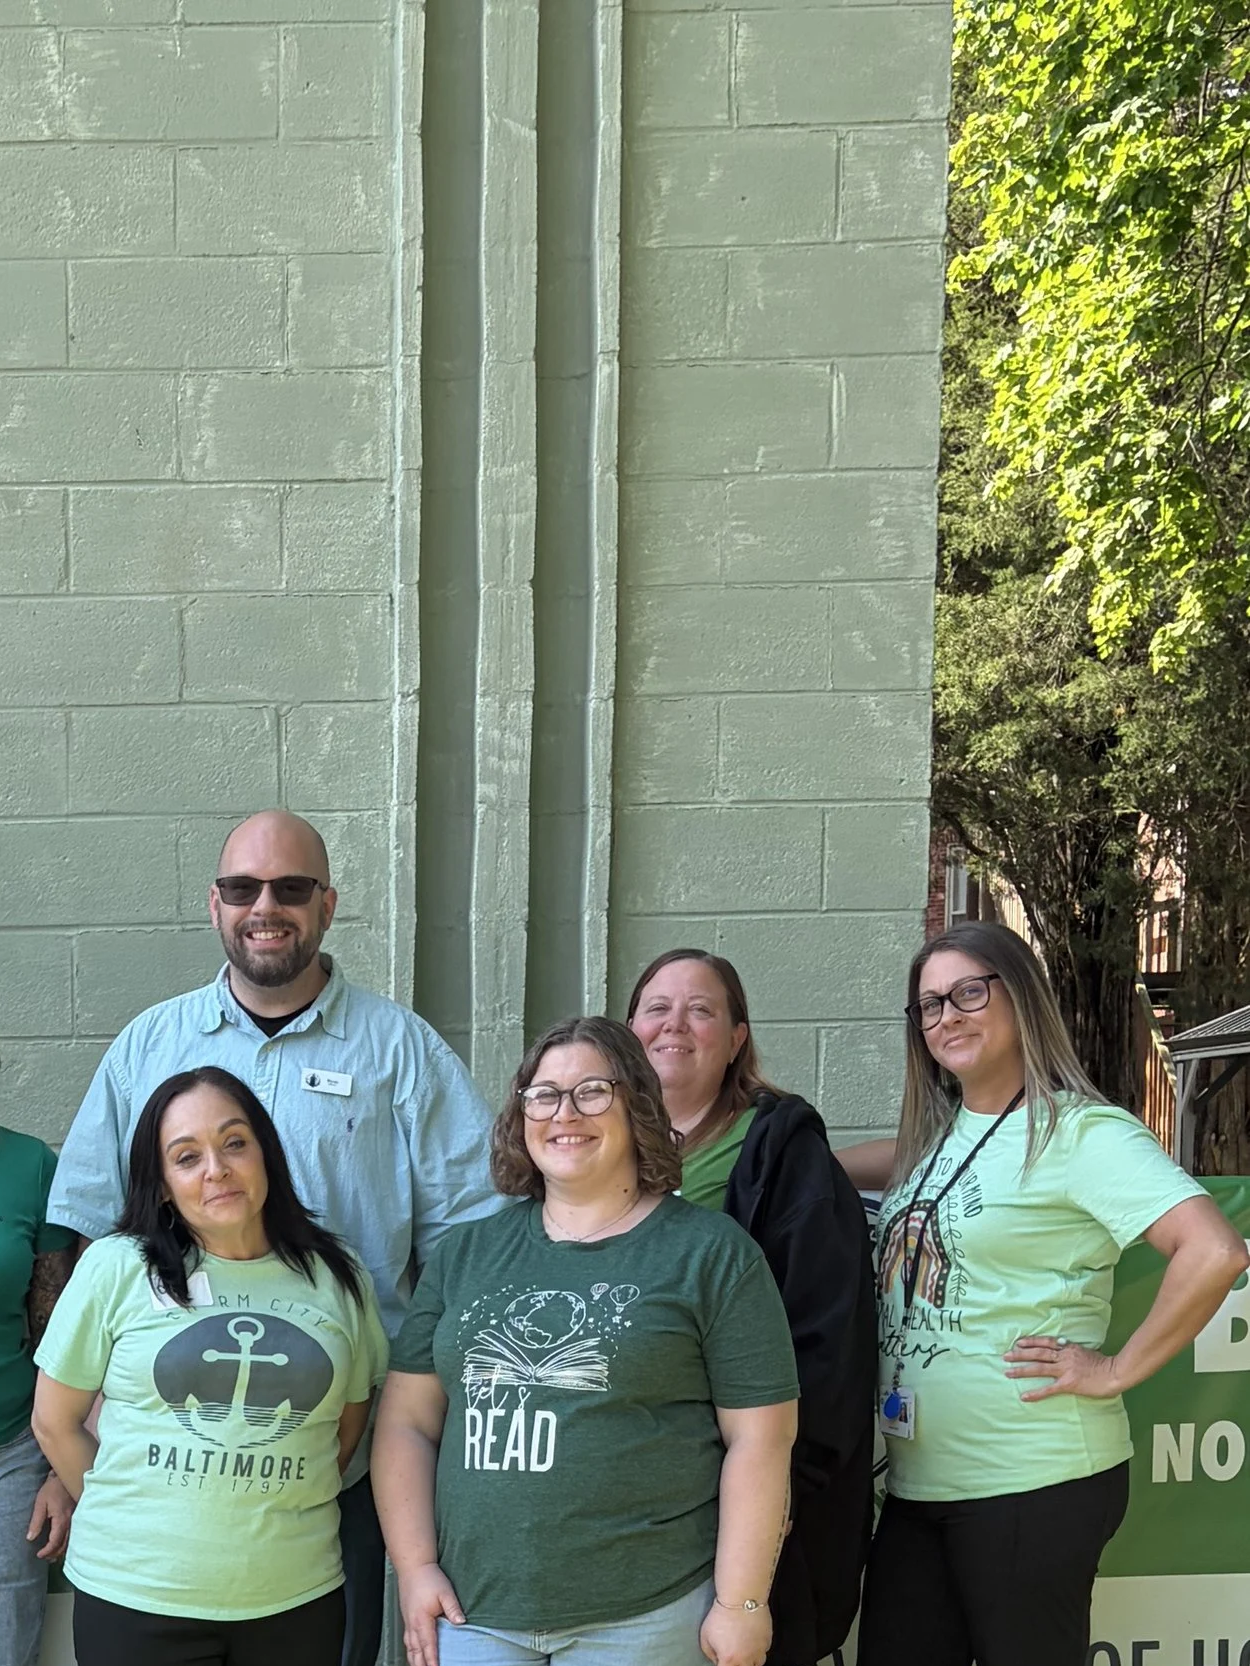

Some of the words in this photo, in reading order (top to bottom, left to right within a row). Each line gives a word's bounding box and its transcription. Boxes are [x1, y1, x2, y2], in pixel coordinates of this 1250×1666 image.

[270, 1299, 328, 1327] CITY
[464, 1408, 557, 1472] READ
[1152, 1420, 1246, 1483] NO
[147, 1443, 306, 1480] BALTIMORE
[167, 1472, 206, 1490] EST
[232, 1479, 286, 1495] 1797
